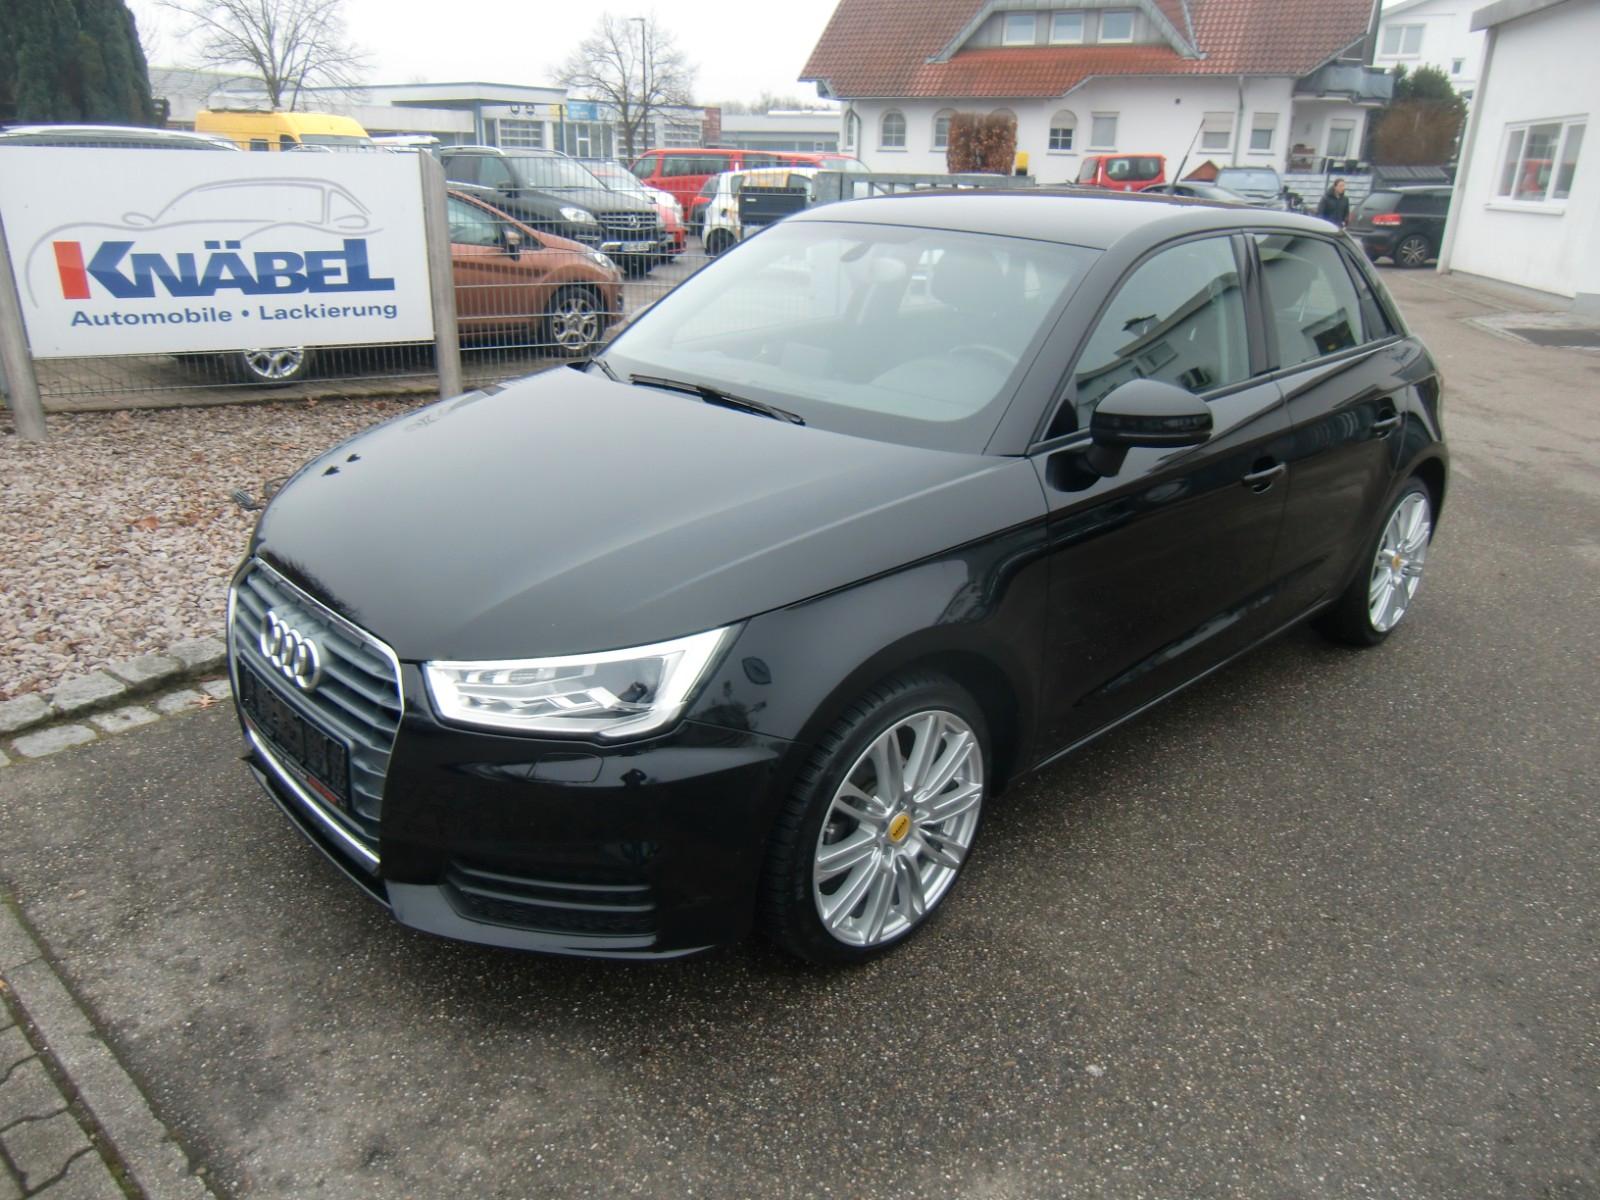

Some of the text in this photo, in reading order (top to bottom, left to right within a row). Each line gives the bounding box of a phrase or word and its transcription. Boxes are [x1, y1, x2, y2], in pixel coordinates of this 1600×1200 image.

[53, 238, 395, 299] KNÄBEL
[71, 303, 397, 326] Automobile Lackierung
